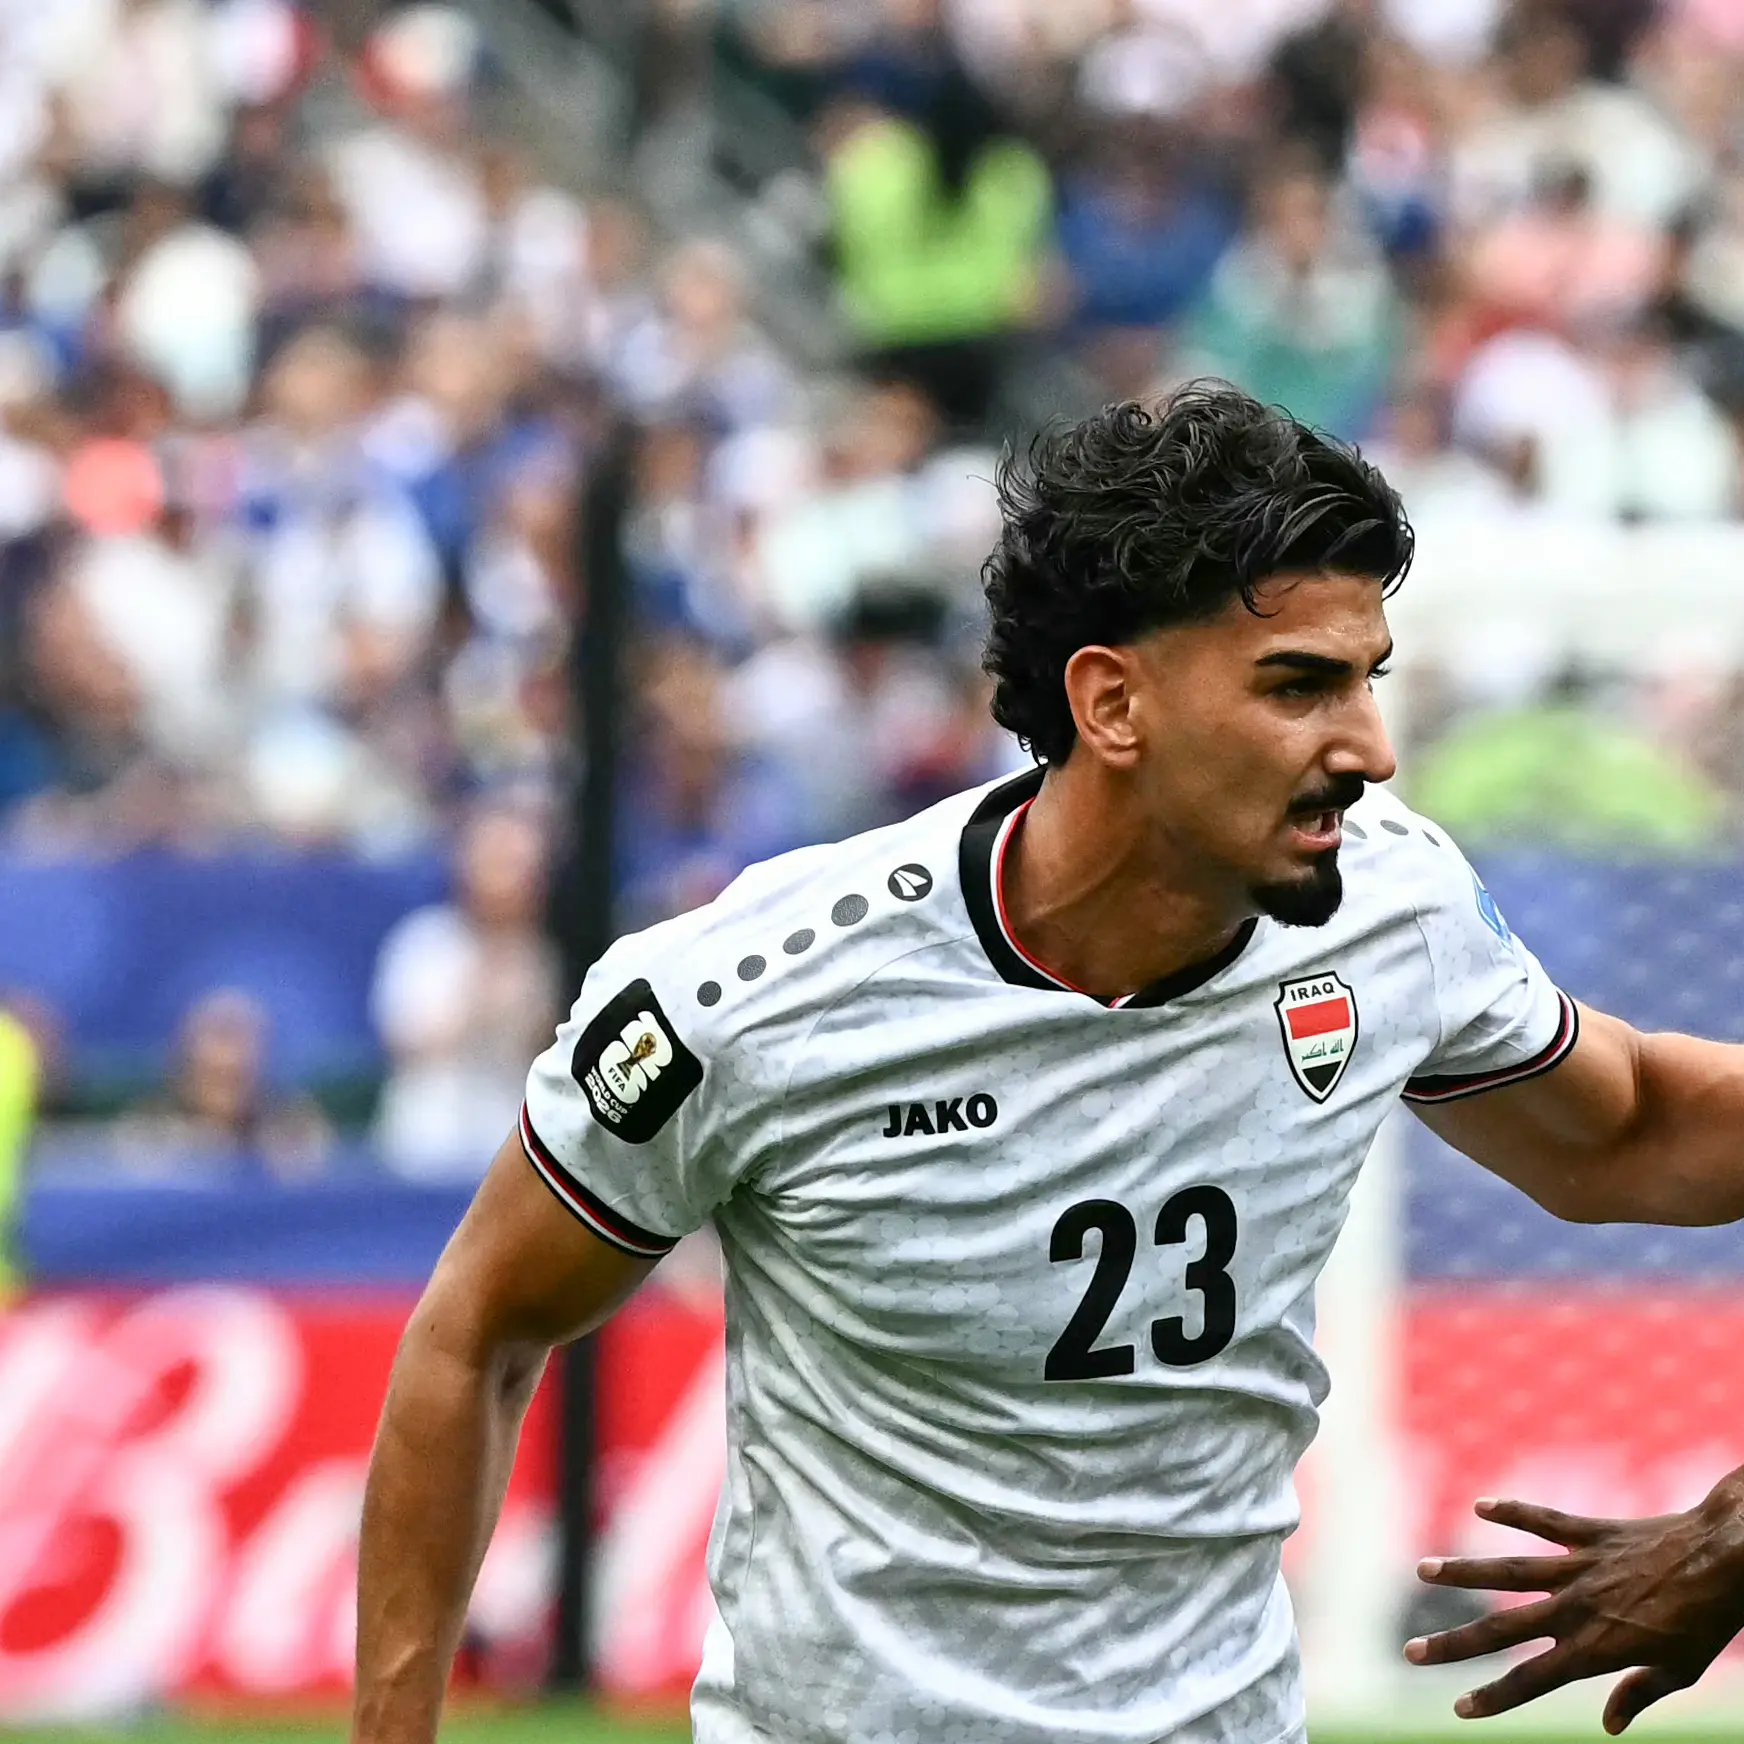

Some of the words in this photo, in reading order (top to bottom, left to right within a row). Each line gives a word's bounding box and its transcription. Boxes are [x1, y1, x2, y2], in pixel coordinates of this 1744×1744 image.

[1290, 981, 1336, 1002] IRAQ
[584, 1072, 623, 1124] 2026
[590, 1065, 612, 1101] WORLD
[610, 1098, 628, 1115] CUP
[607, 1066, 626, 1094] FIFA
[882, 1092, 998, 1138] JAKO
[1043, 1184, 1238, 1382] 23
